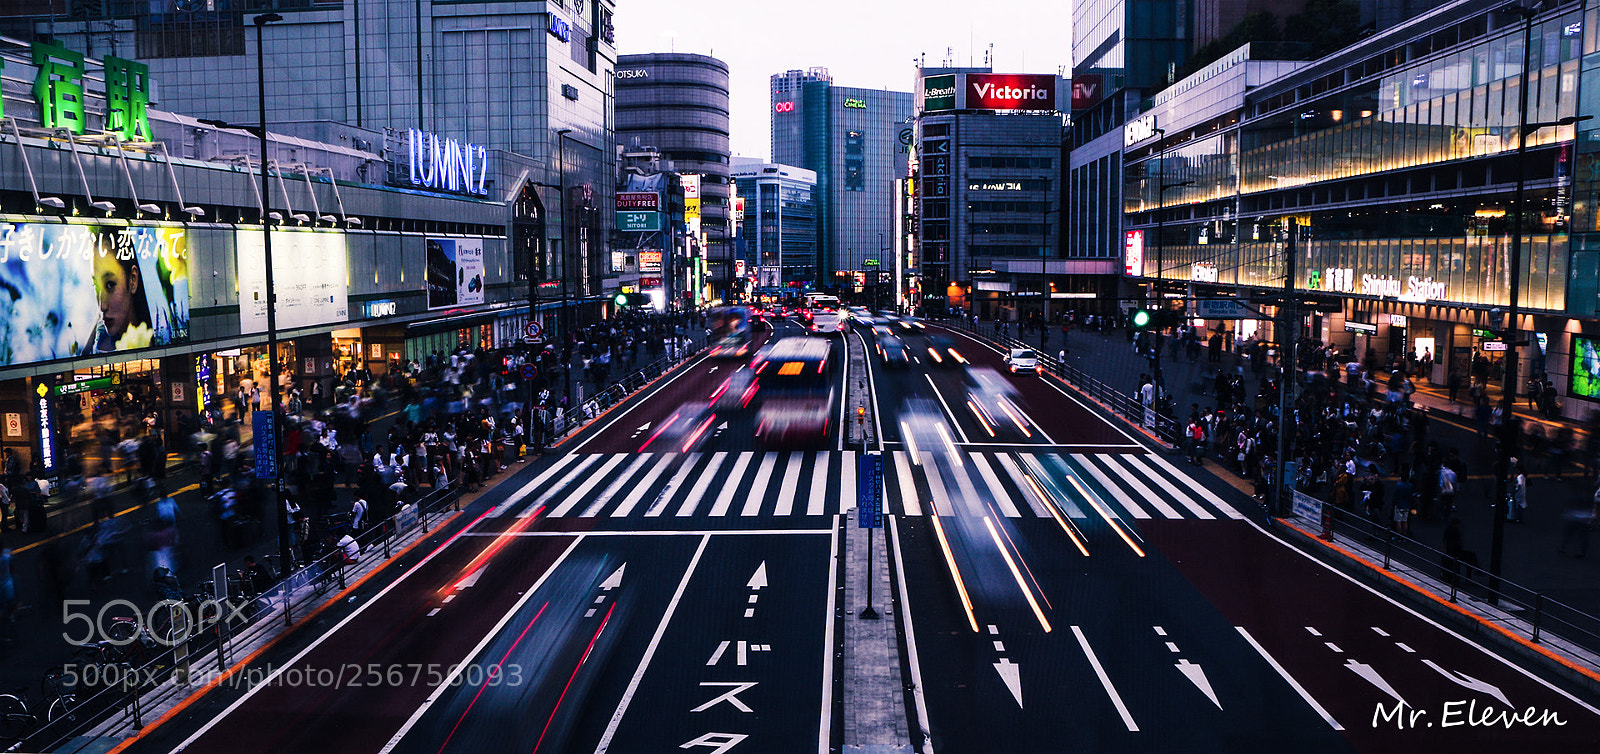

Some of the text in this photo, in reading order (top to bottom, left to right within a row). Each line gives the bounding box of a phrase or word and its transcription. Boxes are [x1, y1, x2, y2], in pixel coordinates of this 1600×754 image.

[617, 70, 648, 79] OTSUKA
[0, 39, 154, 143] 宿駅
[972, 82, 1048, 100] Victoria
[627, 214, 647, 222] ニトリ
[1307, 267, 1448, 300] JR 新宿駅 Shinjuku Station
